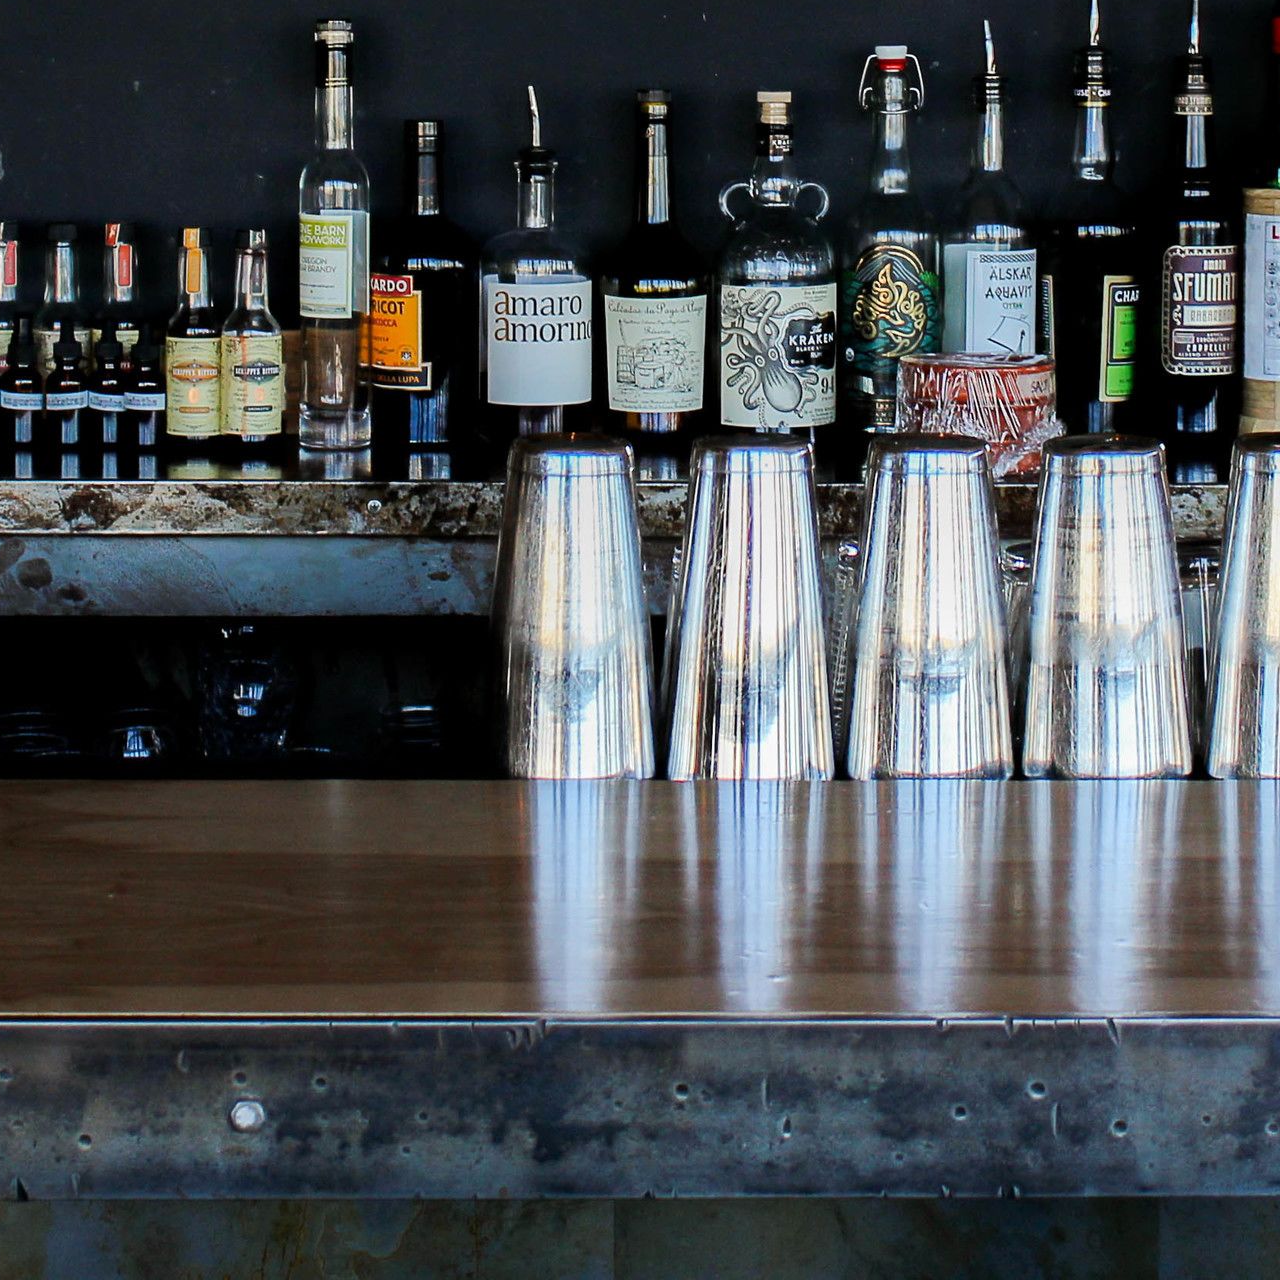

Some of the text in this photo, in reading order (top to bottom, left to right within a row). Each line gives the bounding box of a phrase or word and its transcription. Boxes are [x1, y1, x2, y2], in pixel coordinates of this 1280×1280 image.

[314, 225, 345, 235] BARN
[989, 265, 1032, 281] ÄLSKAR
[985, 286, 1032, 301] AQUAVIT
[1173, 272, 1236, 302] SFUMAT
[494, 291, 583, 316] amaro
[789, 332, 834, 346] KRAKEN
[398, 375, 420, 383] LUPA
